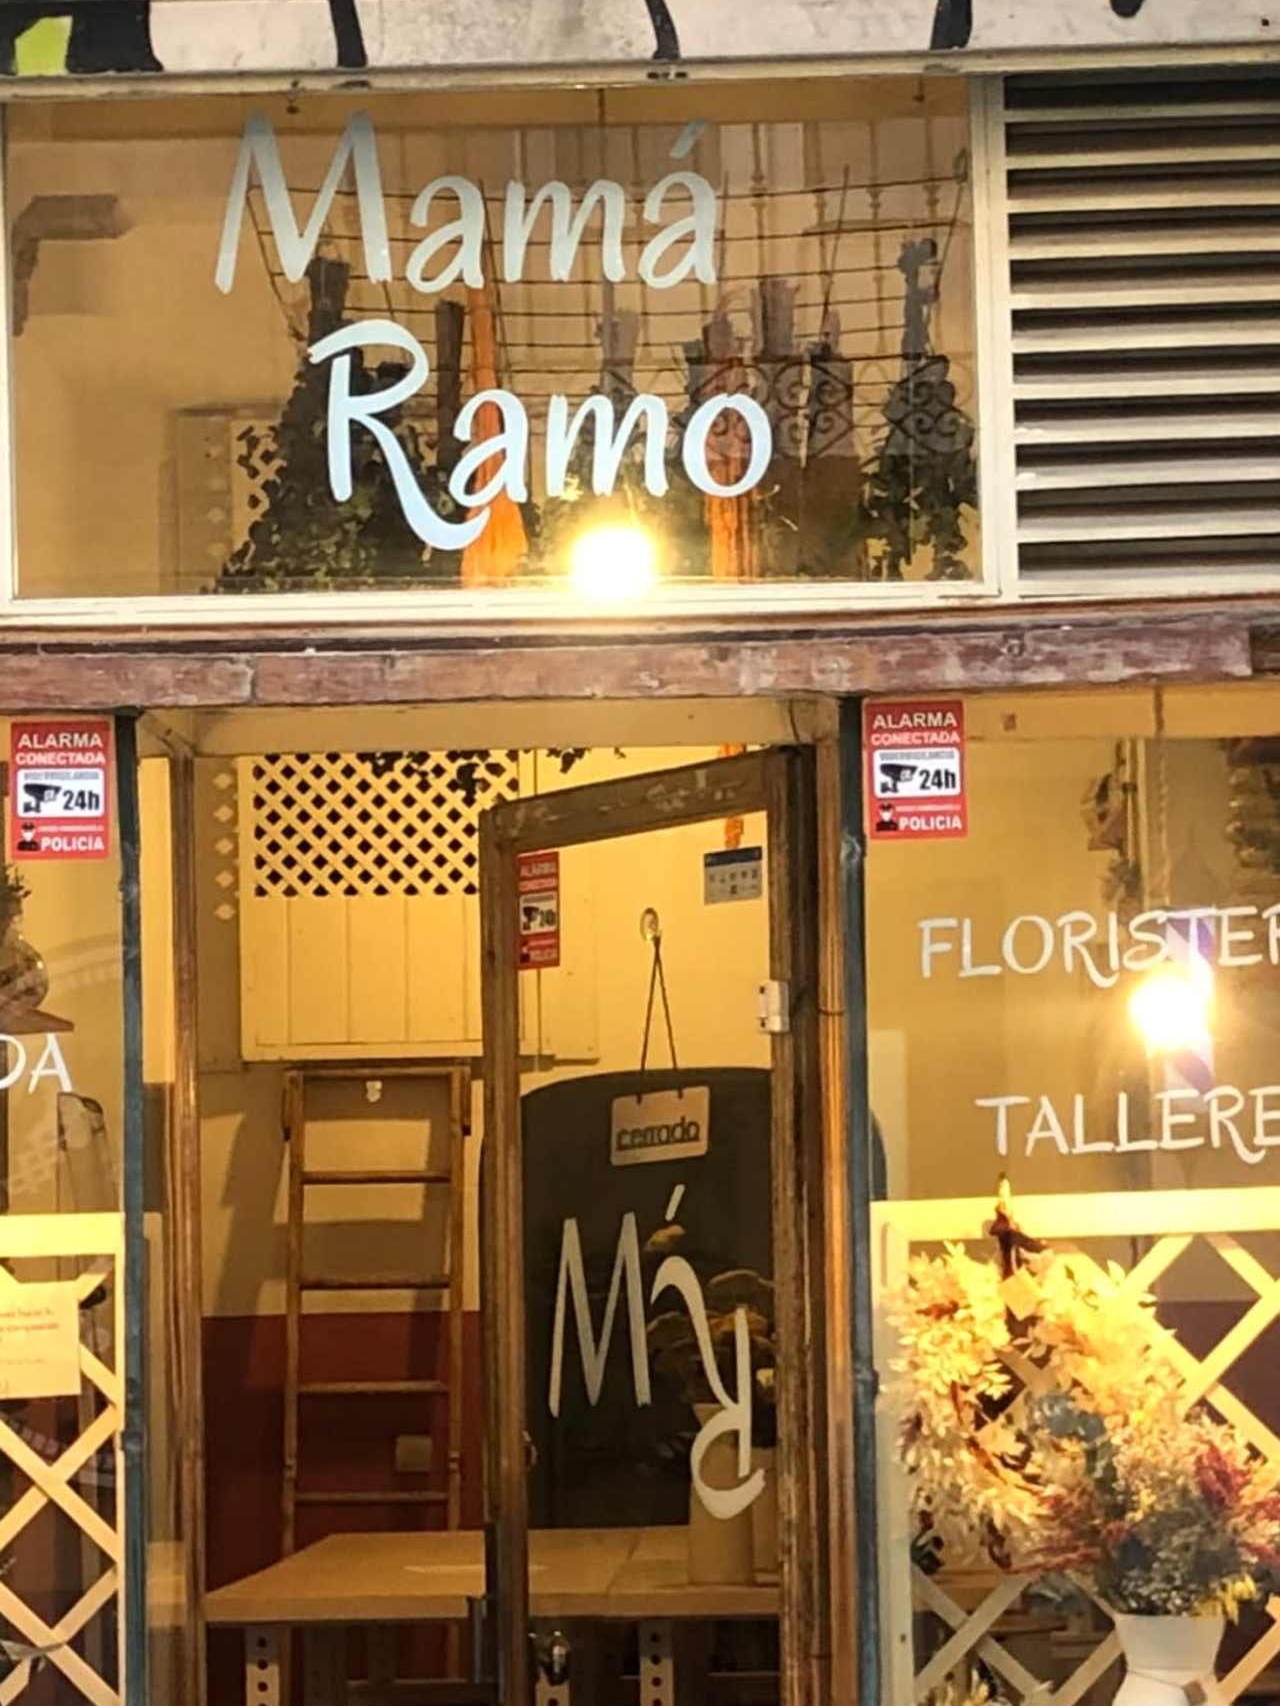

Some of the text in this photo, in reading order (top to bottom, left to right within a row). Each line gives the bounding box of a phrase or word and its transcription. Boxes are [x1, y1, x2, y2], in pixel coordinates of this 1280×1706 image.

[214, 107, 718, 295] Mamá
[306, 317, 775, 553] Ramo
[872, 712, 959, 730] ALARMA
[17, 733, 105, 749] ALARMA
[871, 731, 961, 746] CONECTADA
[15, 751, 106, 765] CONECTADA
[919, 768, 957, 791] 24h
[62, 789, 100, 811] 24h
[616, 1114, 700, 1152] cerrado
